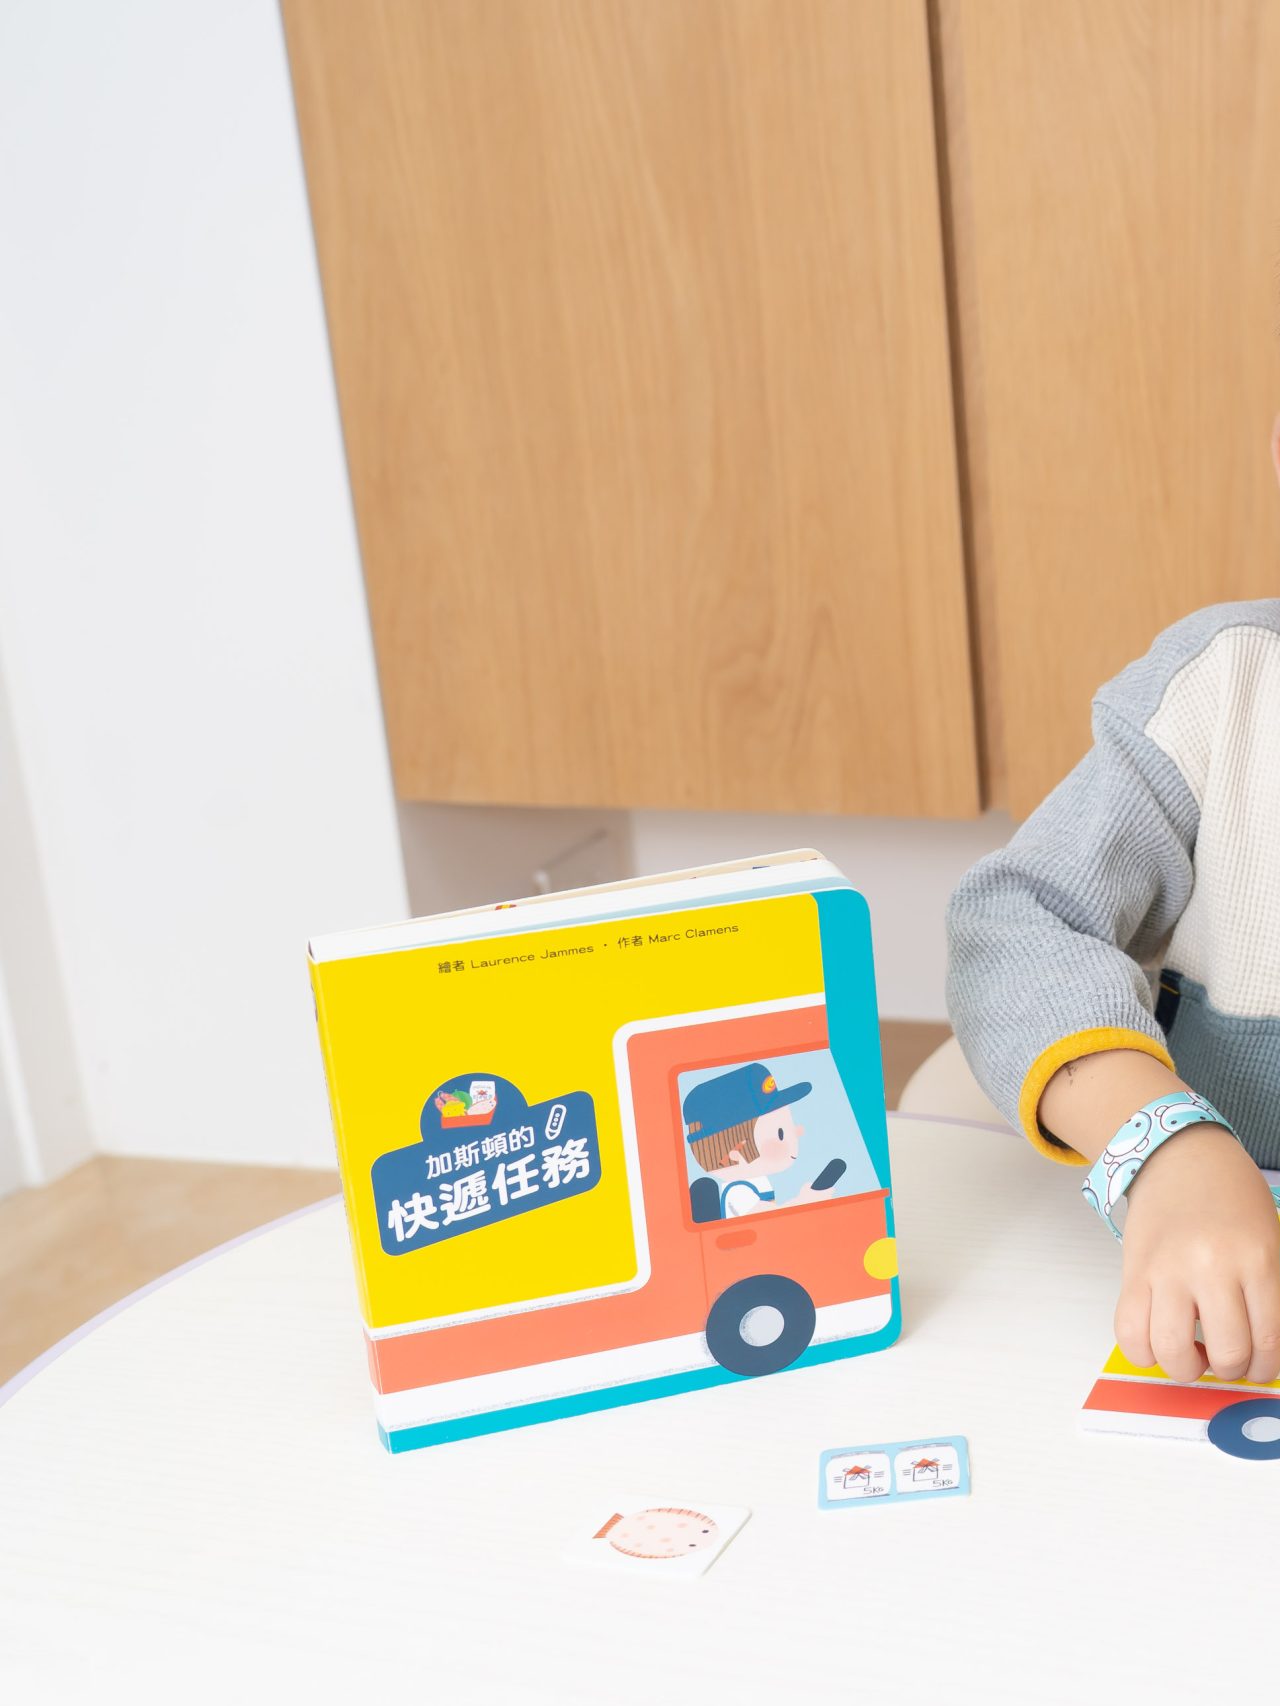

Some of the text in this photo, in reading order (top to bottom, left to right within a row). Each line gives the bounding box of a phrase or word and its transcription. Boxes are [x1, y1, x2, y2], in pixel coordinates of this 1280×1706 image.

[438, 924, 739, 974] 繪者 Laurence Jammes 作者 Marc Clamens
[425, 1125, 536, 1180] 加斯頓的
[387, 1137, 590, 1242] 快遞任務
